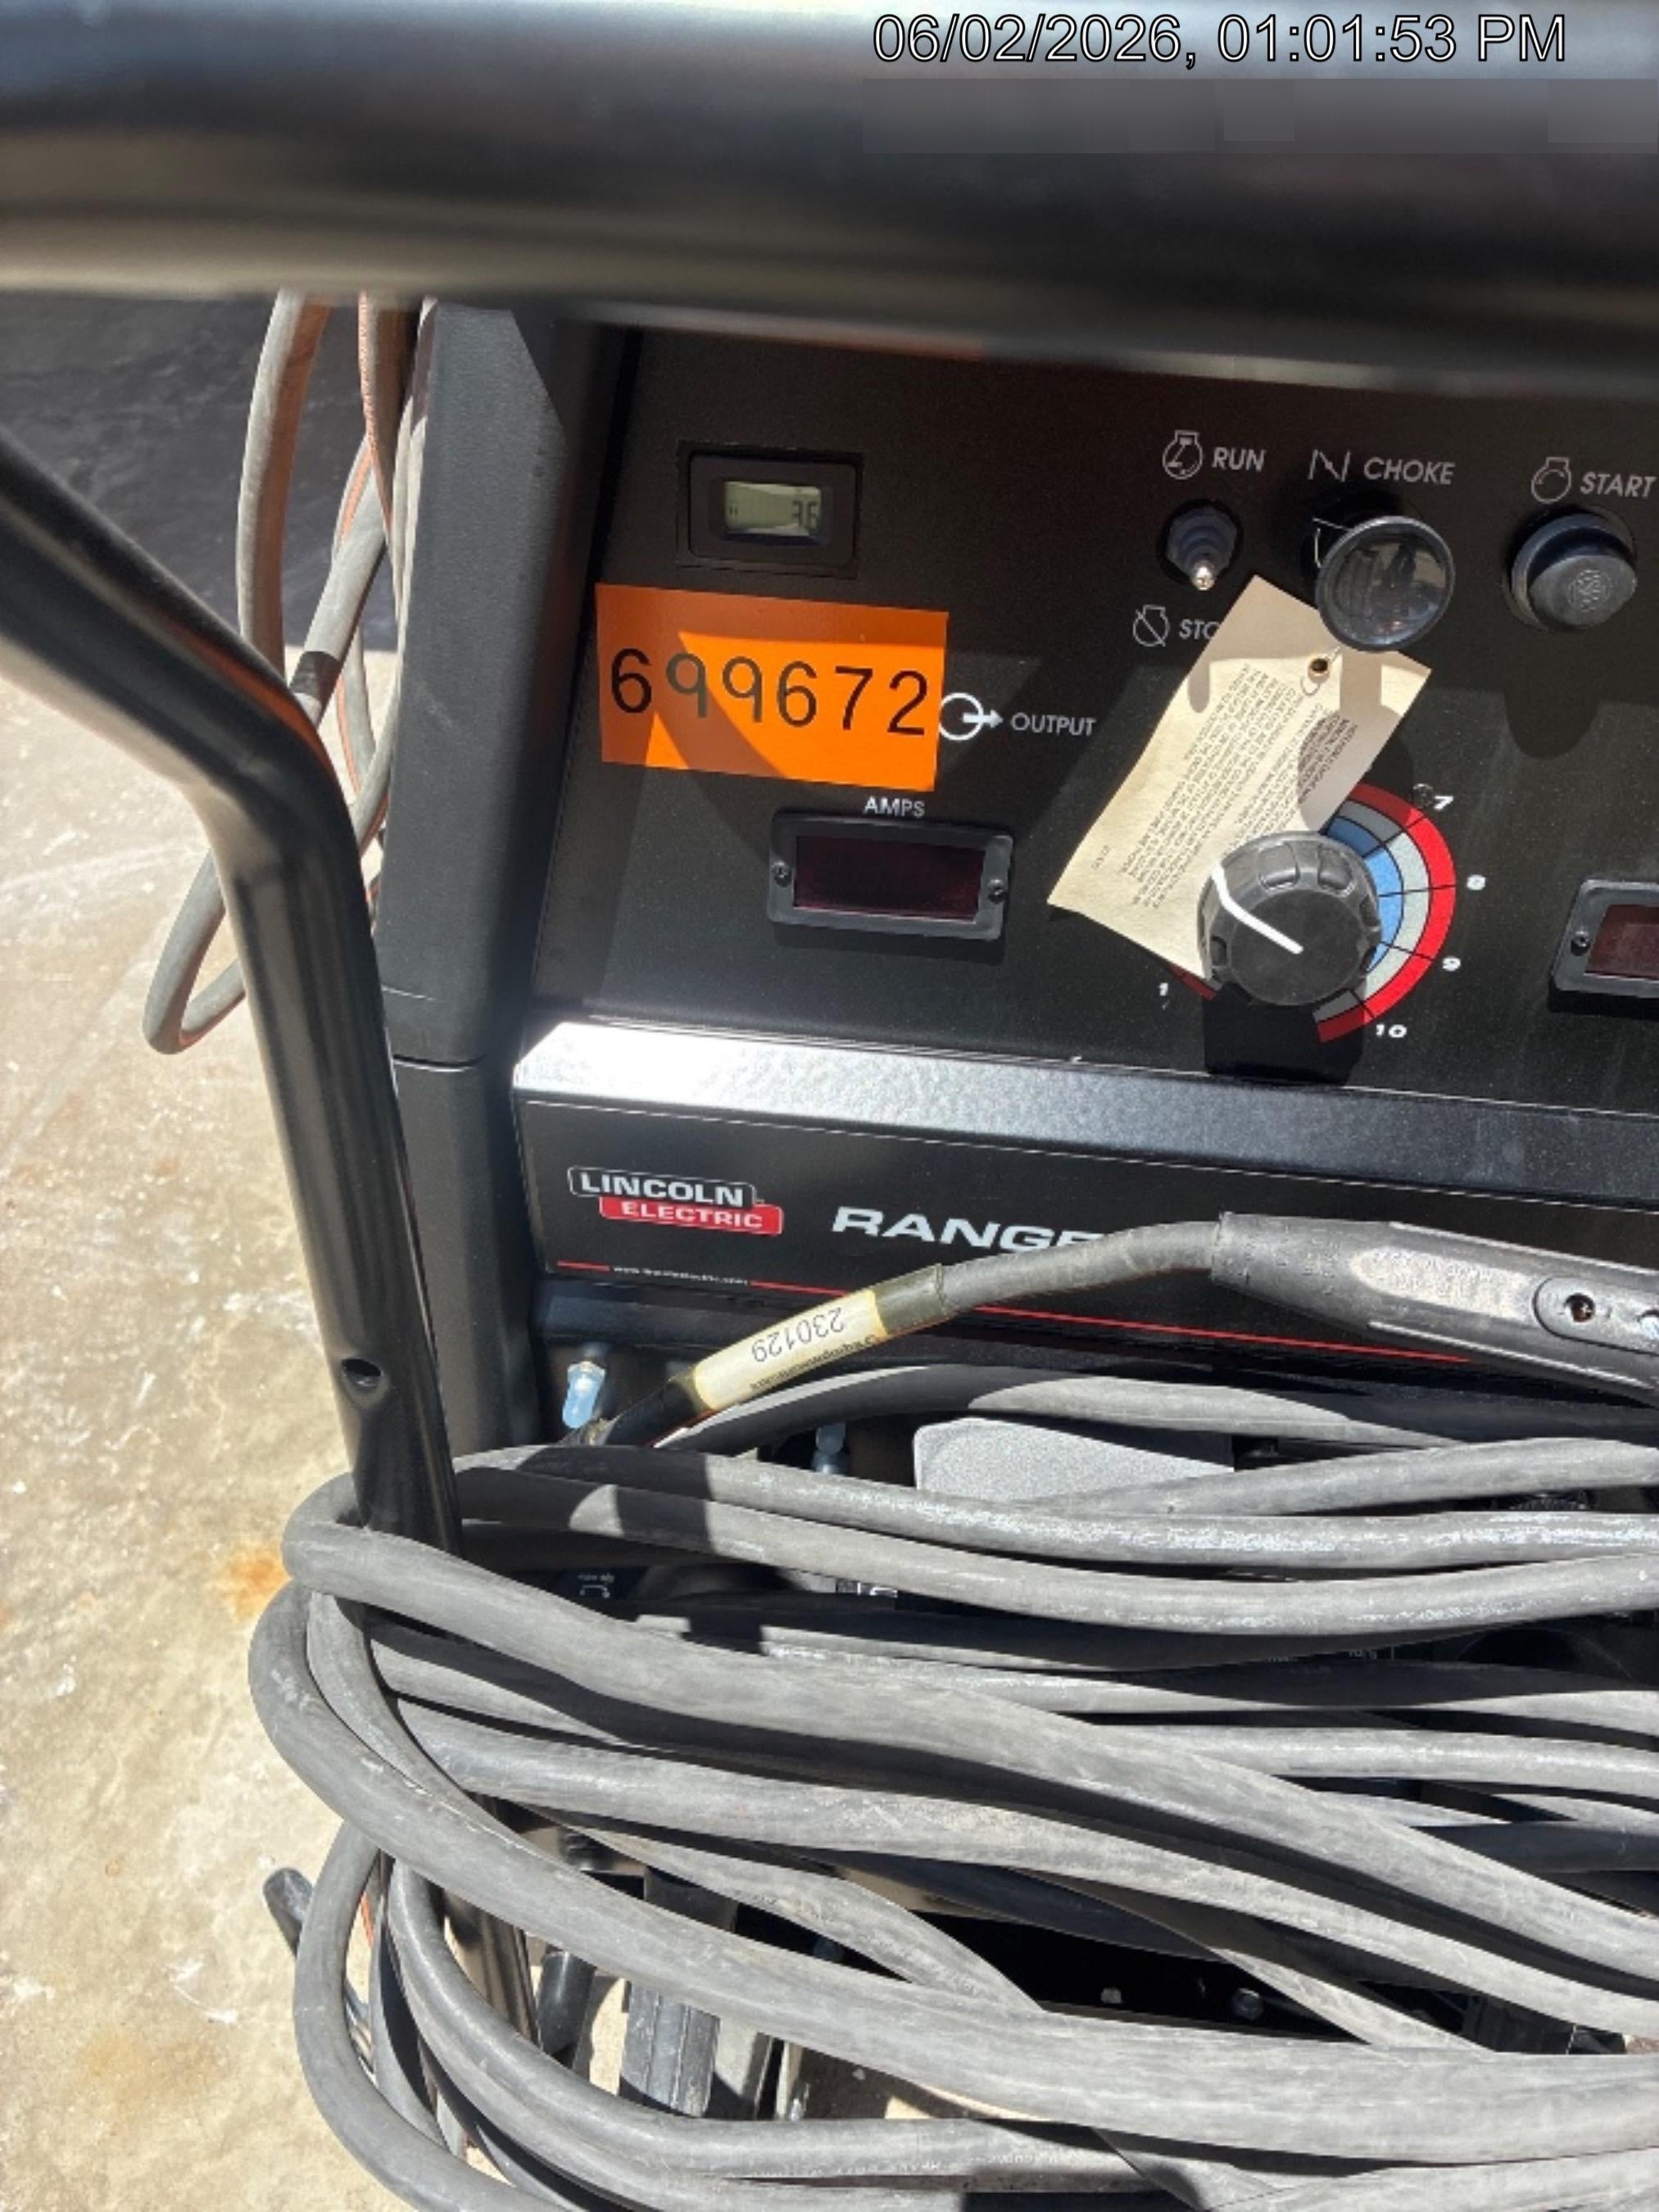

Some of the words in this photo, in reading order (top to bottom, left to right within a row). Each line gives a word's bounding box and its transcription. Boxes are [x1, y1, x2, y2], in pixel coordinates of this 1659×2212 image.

[1212, 448, 1267, 473] RUN
[1363, 457, 1456, 484] CHOKE
[1580, 471, 1657, 498] START
[1179, 618, 1222, 640] STO
[610, 647, 928, 736] 699672
[1010, 711, 1095, 737] OUTPUT
[864, 796, 926, 818] AMPS
[1433, 795, 1454, 810] 7
[1466, 873, 1485, 891] 8
[1441, 956, 1461, 971] 9
[1158, 982, 1169, 996] 1
[1375, 1023, 1407, 1038] 10
[580, 1172, 744, 1207] LINCOLN
[621, 1201, 764, 1230] ELECTRIC
[751, 1305, 845, 1363] 230129
